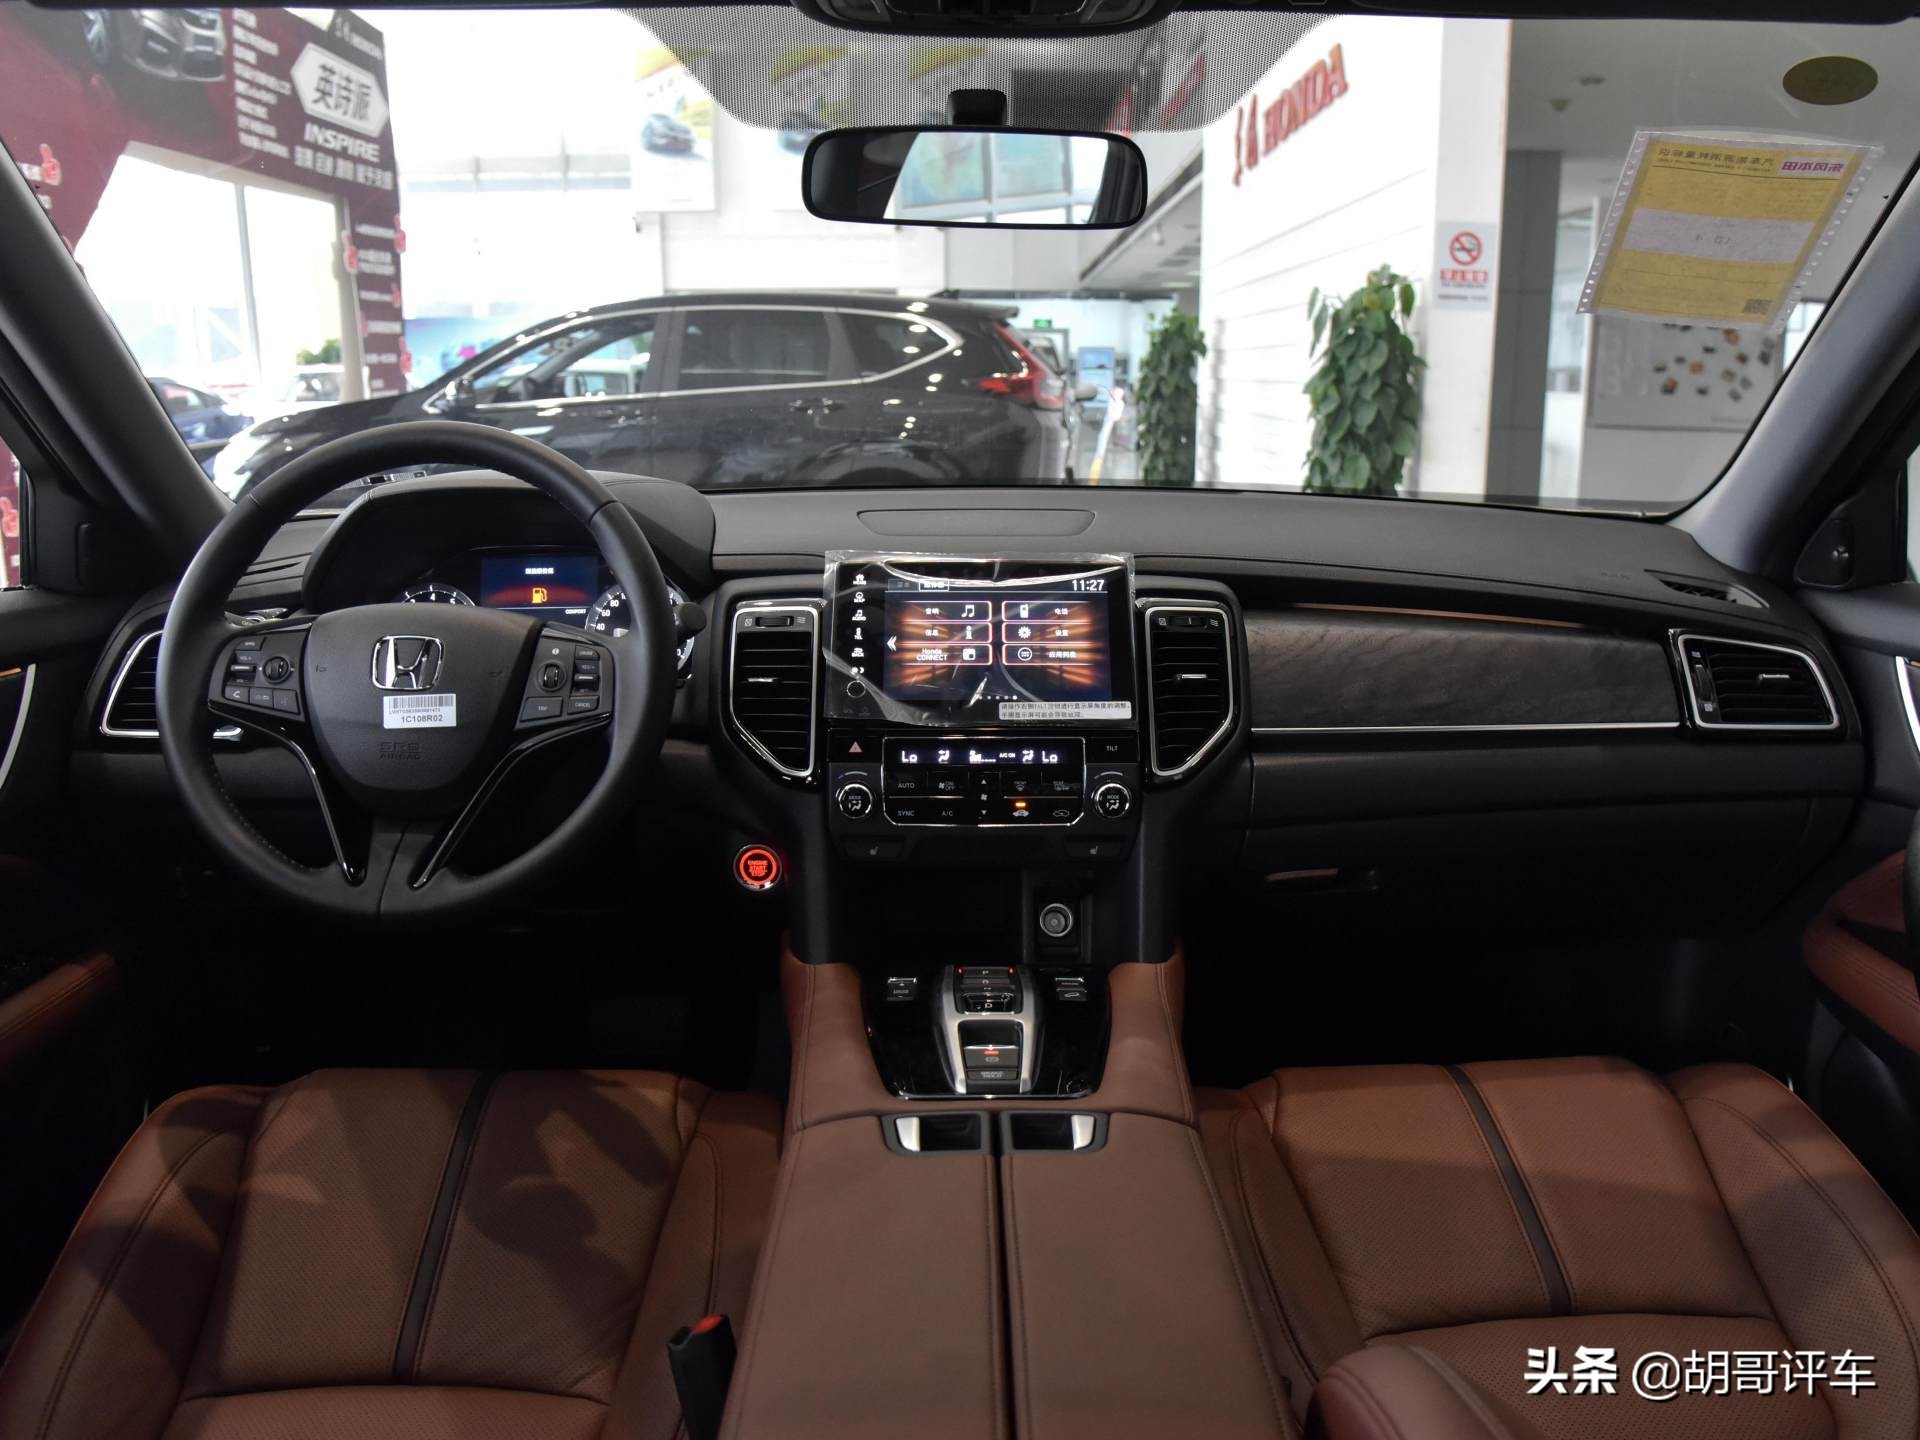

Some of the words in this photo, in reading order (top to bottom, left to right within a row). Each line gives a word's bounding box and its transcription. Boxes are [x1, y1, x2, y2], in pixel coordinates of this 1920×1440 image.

[312, 63, 372, 120] 英诗派
[1262, 42, 1349, 157] HONDA
[304, 122, 381, 163] INSPIRE
[1071, 579, 1105, 591] 11:27
[430, 592, 436, 601] 4
[609, 600, 620, 608] 80
[596, 622, 606, 631] 40
[901, 750, 918, 764] Lo
[1041, 750, 1058, 763] Lo
